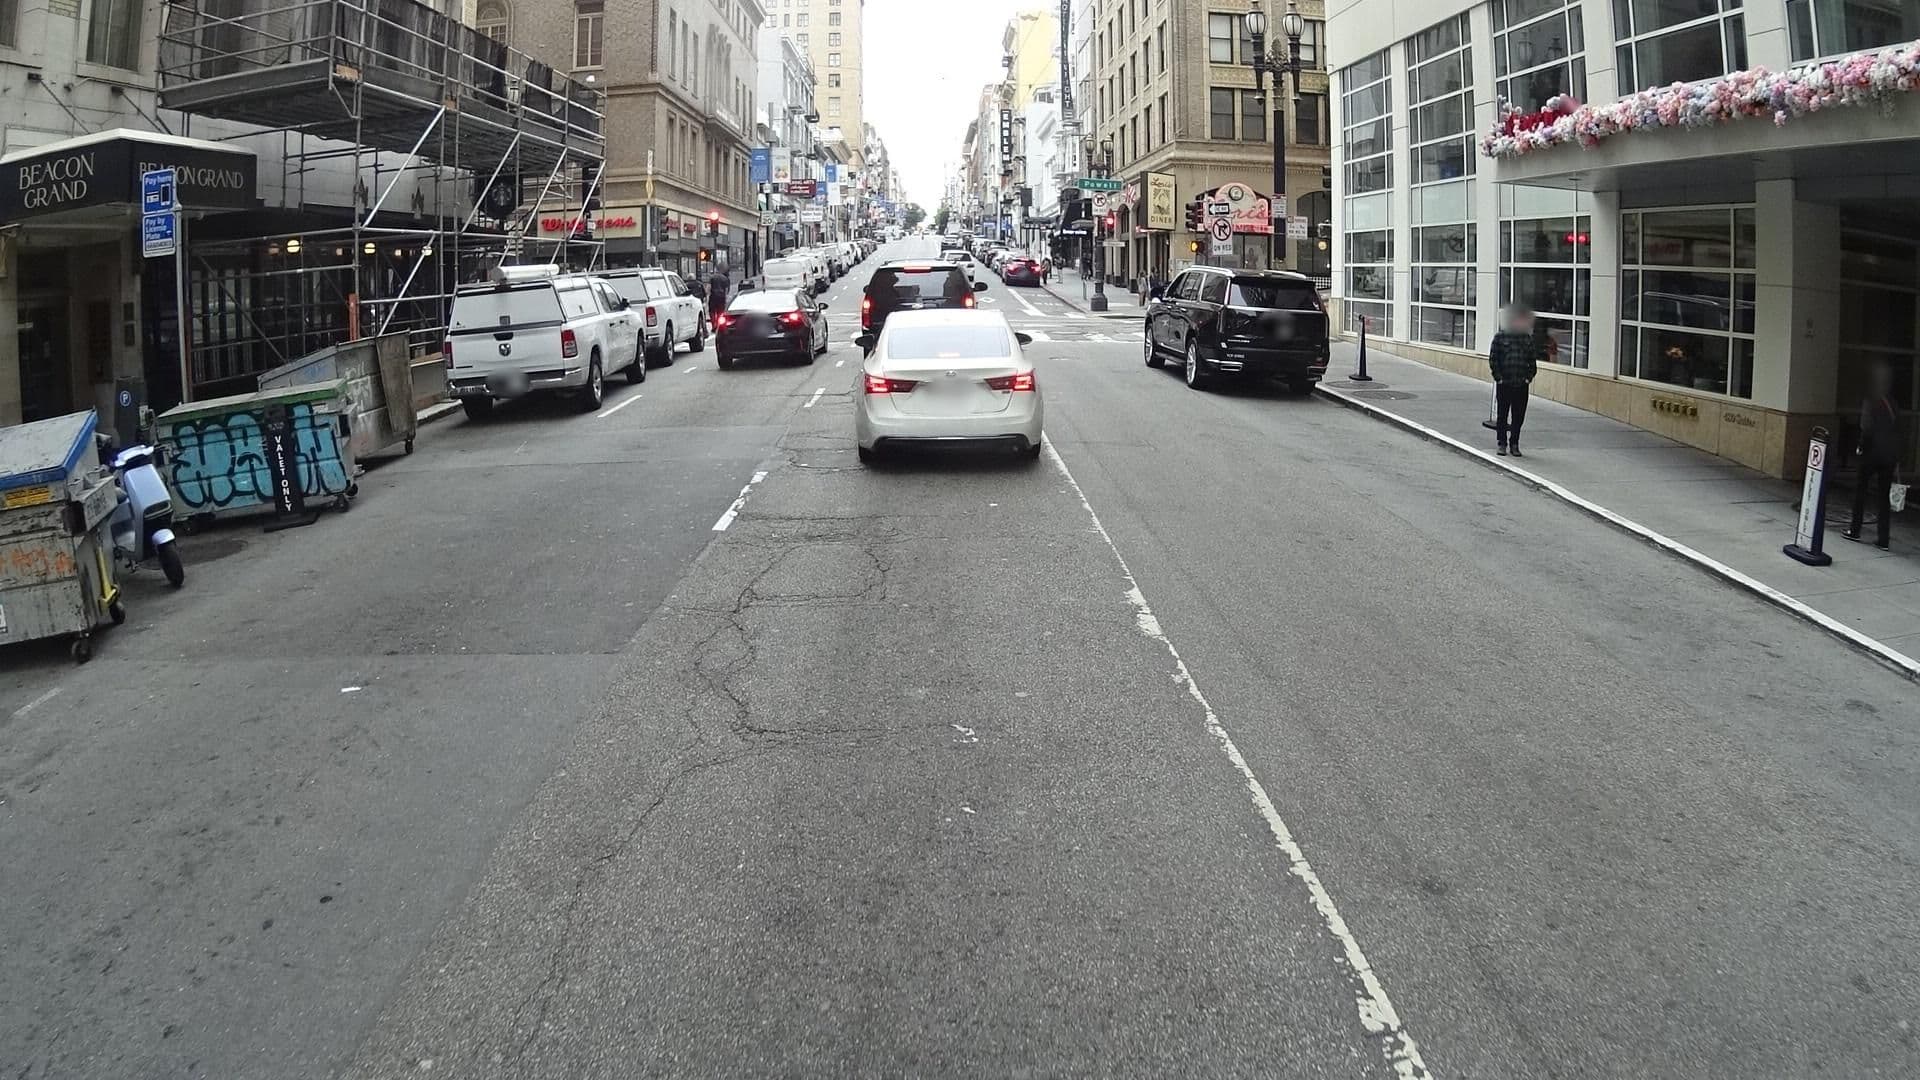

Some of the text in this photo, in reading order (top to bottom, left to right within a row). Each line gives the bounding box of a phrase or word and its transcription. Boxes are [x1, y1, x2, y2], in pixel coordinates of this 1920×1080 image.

[19, 153, 95, 190] BEACON
[145, 177, 157, 185] Pay
[197, 168, 243, 189] GRAND
[24, 180, 88, 209] GRAND
[1084, 181, 1117, 189] Powell
[1214, 244, 1232, 252] ON RED
[274, 435, 286, 476] VALET
[281, 479, 292, 512] ONLY
